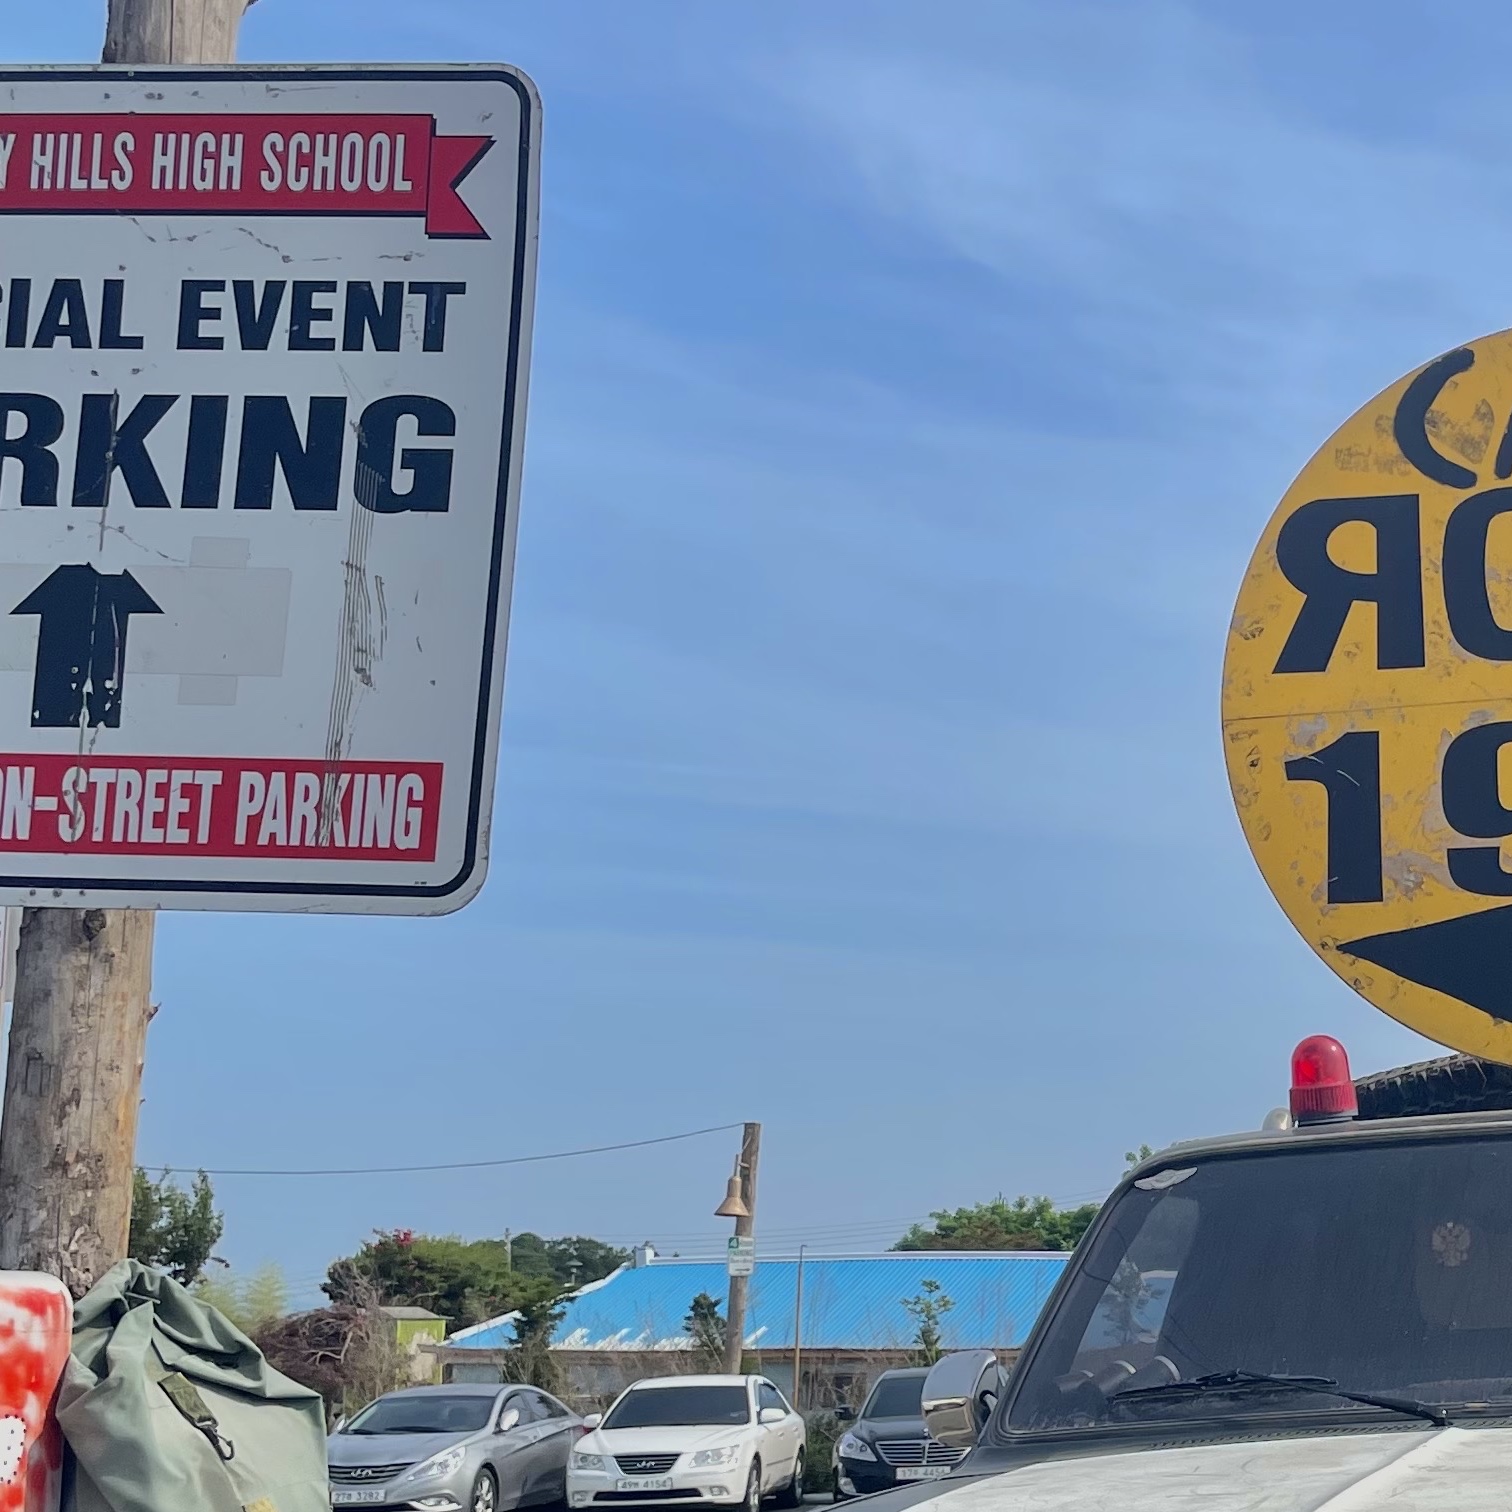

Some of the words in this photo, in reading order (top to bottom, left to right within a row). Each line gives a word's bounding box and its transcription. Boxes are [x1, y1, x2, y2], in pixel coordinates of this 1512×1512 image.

[30, 132, 135, 191] HILLS
[151, 132, 243, 191] HIGH
[260, 132, 412, 192] SCHOOL
[0, 278, 144, 349] IAL
[176, 279, 467, 352] EVENT
[0, 766, 223, 845] N-STREET
[234, 769, 424, 850] PARKING
